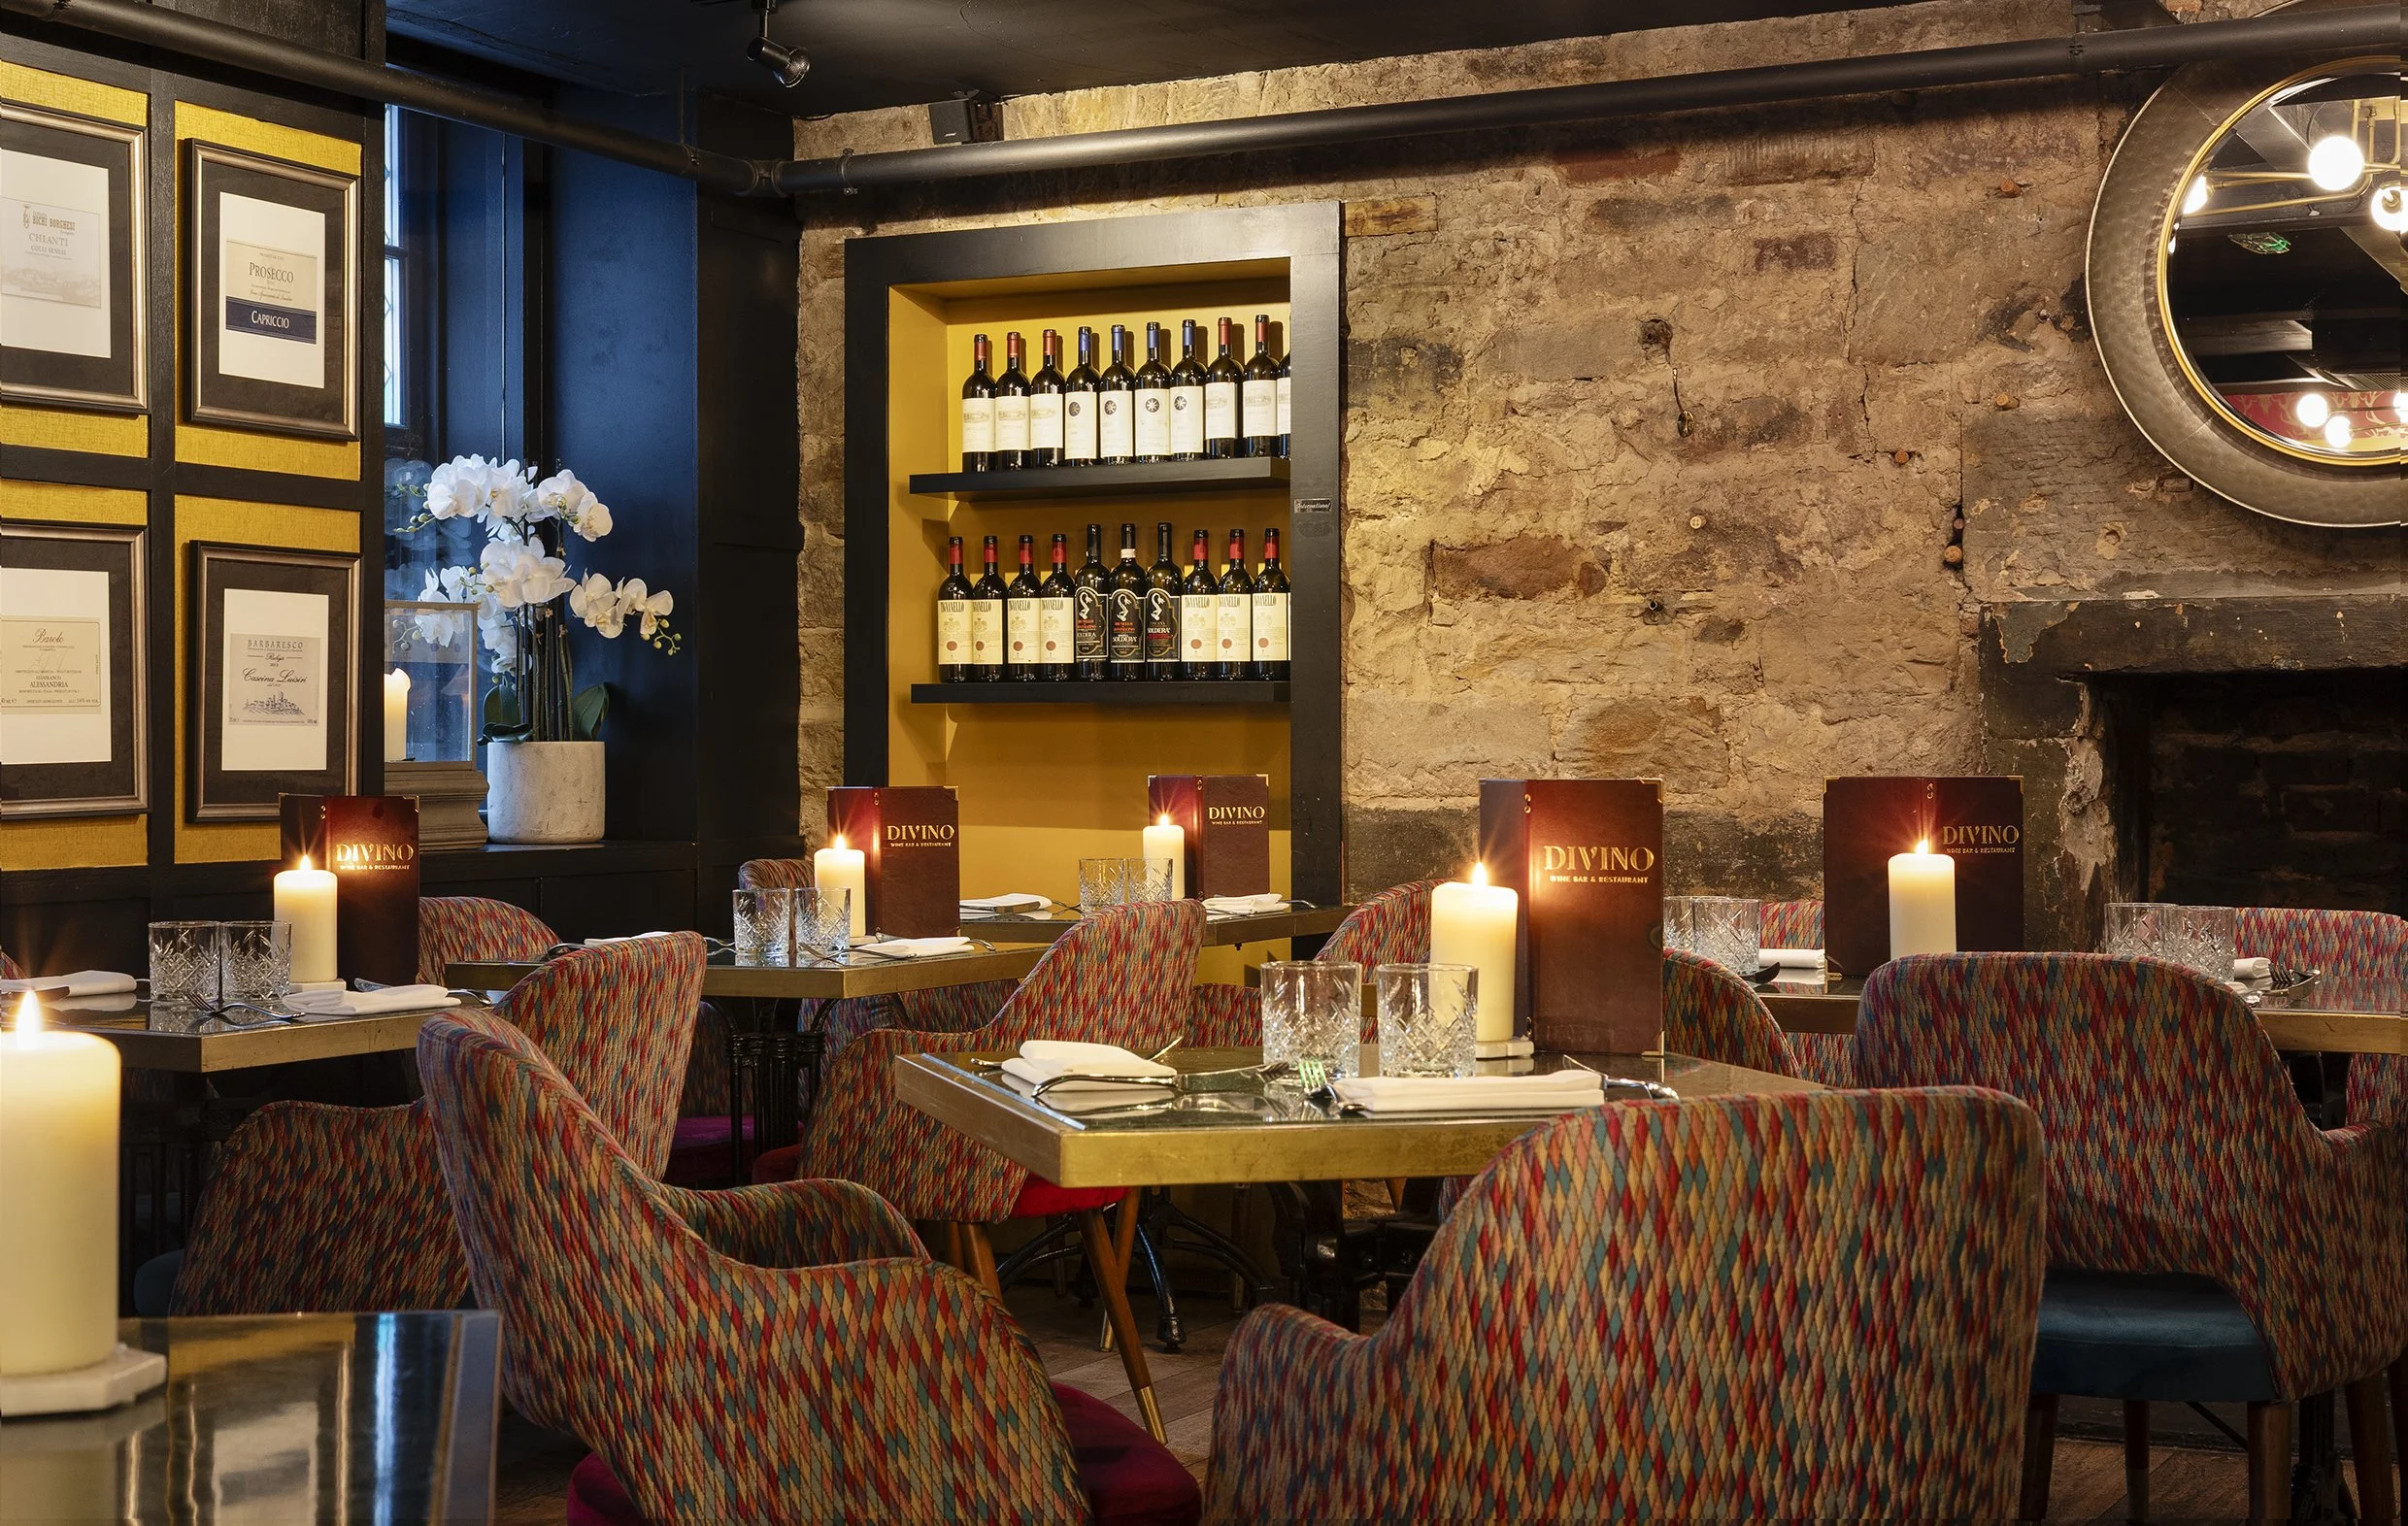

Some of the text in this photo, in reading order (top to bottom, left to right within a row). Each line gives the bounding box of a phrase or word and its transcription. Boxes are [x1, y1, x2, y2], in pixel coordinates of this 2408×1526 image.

[28, 233, 69, 247] CHIANTI
[249, 262, 294, 283] PROSECCO
[251, 310, 290, 329] CAPRICCIO
[32, 628, 64, 643] Barolo
[248, 640, 304, 649] BARBARESCO
[242, 668, 275, 682] Cascina
[1208, 806, 1265, 819] DIVINO
[886, 824, 955, 841] DIVINO
[1942, 824, 2020, 845] DIVINO
[335, 843, 415, 862] DIVINO
[1543, 846, 1656, 872] DIVINO
[1550, 875, 1571, 883] WINE
[1573, 875, 1588, 883] BAR
[1598, 875, 1649, 884] RESTAURANT
